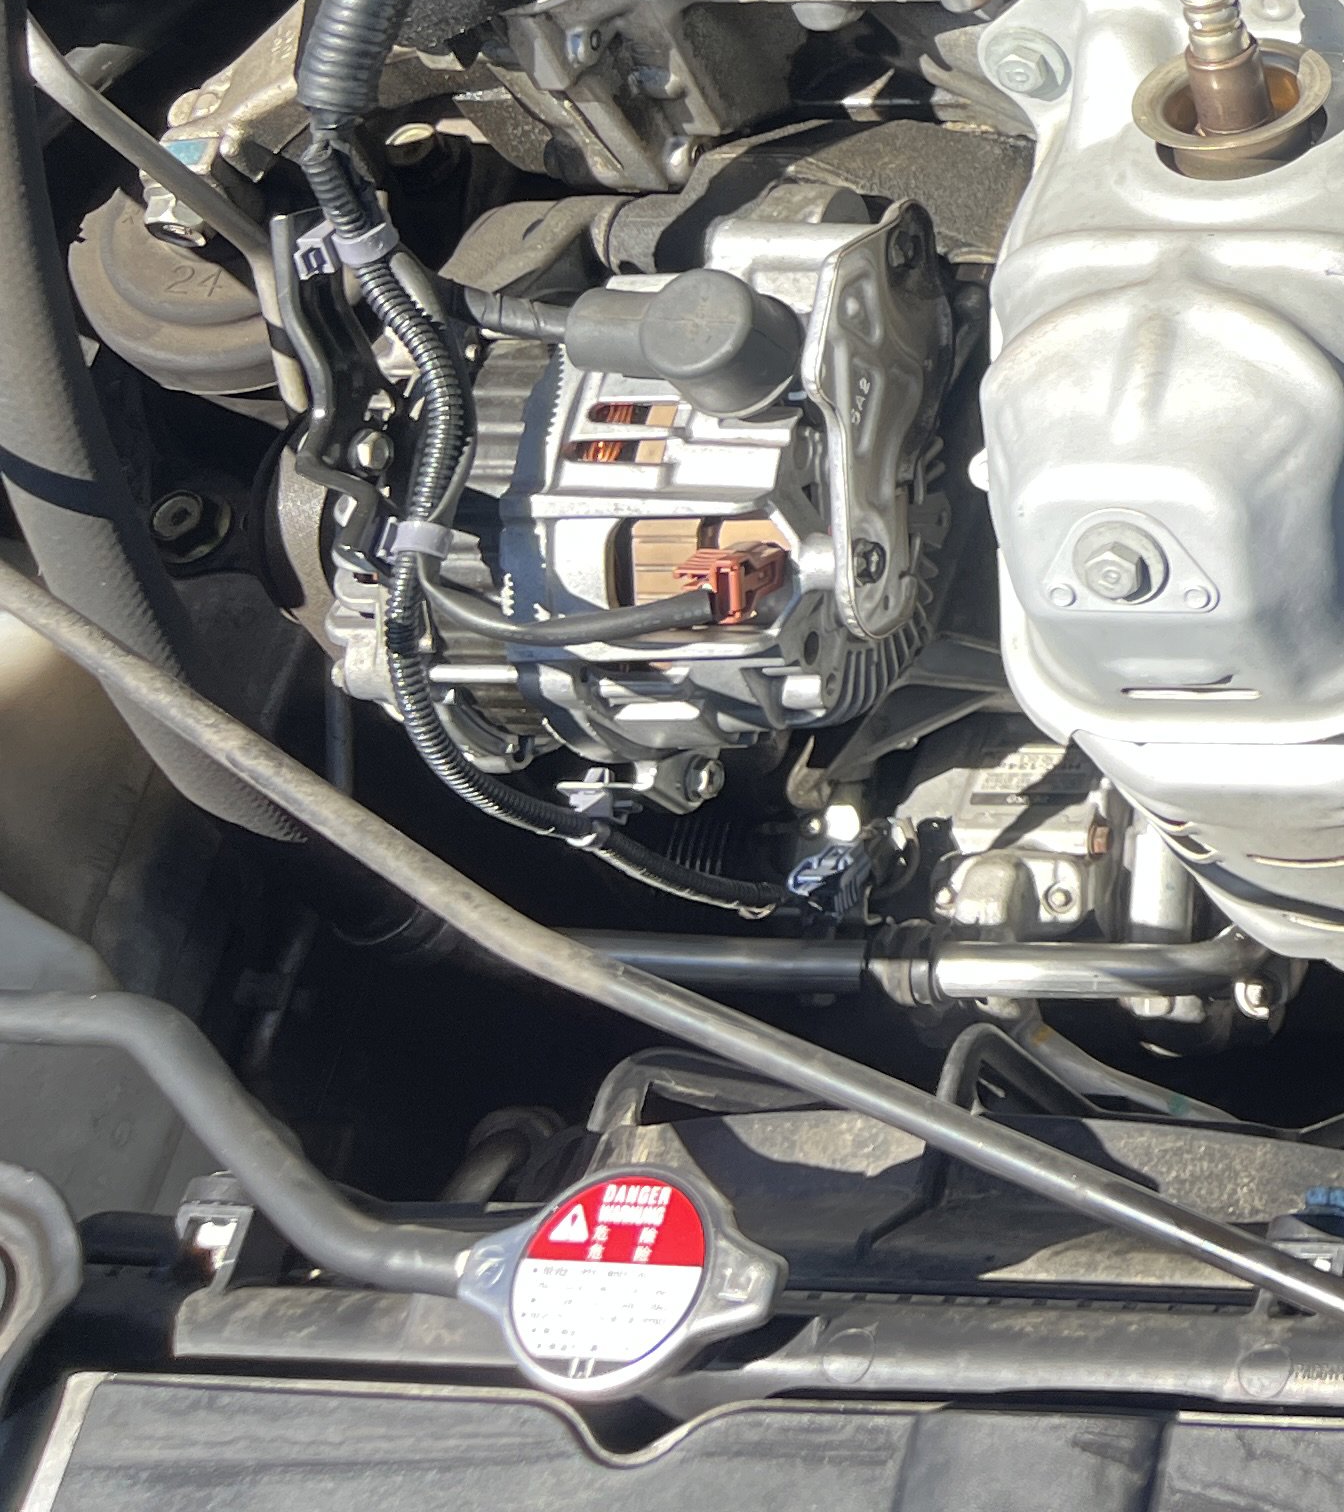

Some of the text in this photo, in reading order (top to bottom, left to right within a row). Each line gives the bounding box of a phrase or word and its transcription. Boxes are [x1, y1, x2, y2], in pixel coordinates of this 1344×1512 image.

[164, 264, 223, 297] 24
[602, 1184, 673, 1205] DANGER
[598, 1203, 667, 1226] WARNING
